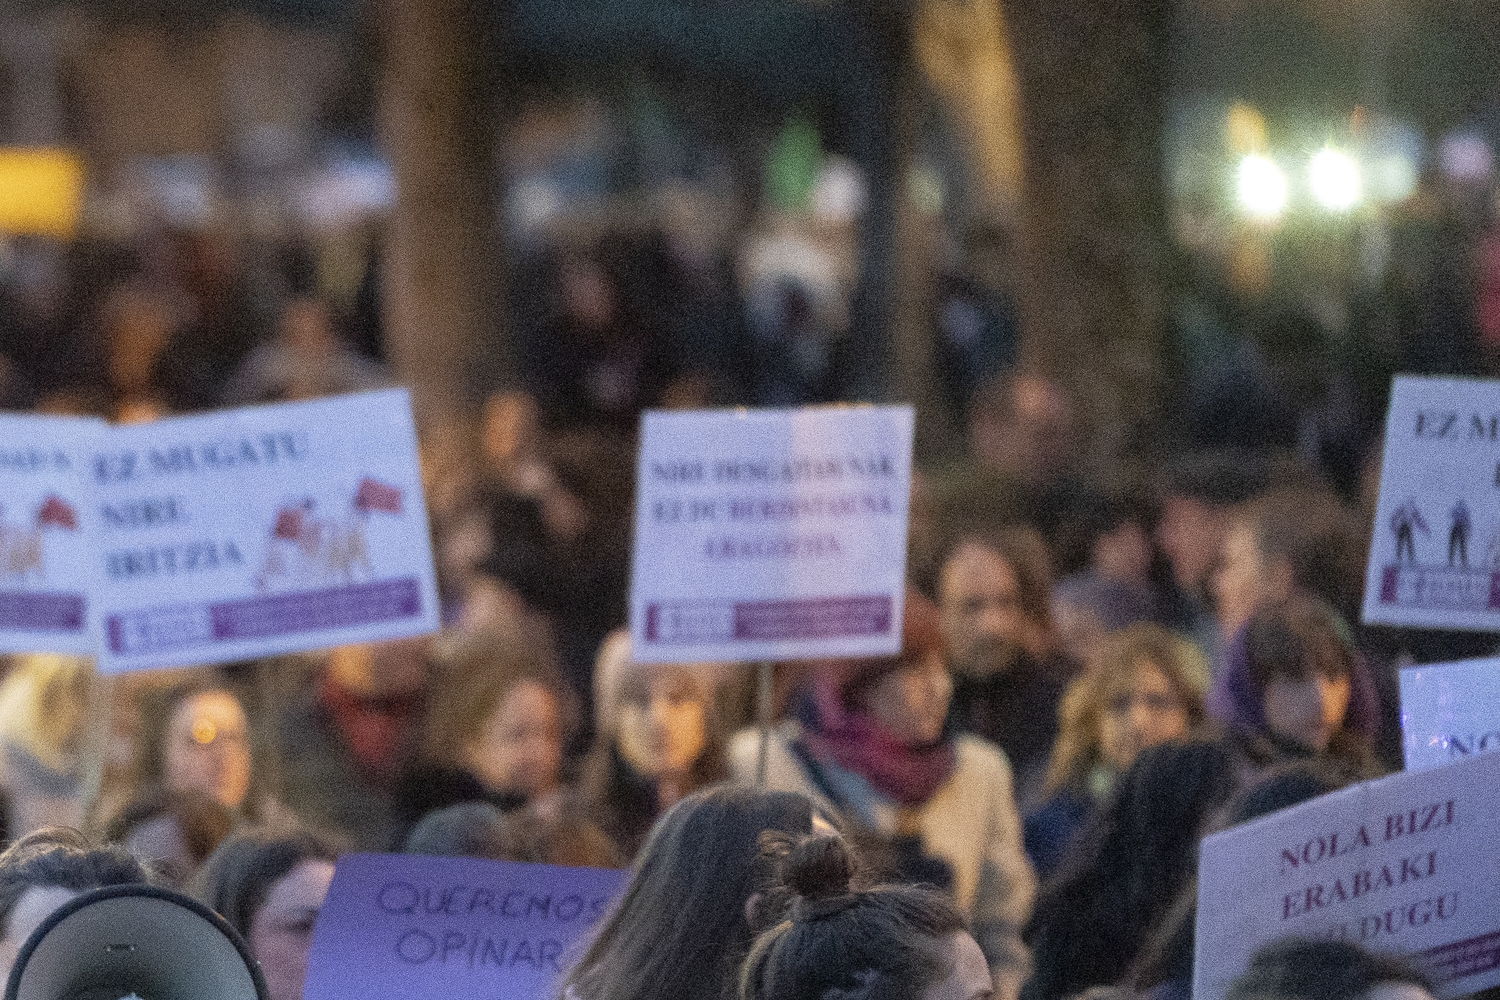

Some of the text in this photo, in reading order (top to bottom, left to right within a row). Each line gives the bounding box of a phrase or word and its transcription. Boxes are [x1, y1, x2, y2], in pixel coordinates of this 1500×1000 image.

[1415, 411, 1458, 438] EZ
[1280, 799, 1457, 876] NOLA BIZI
[1280, 850, 1438, 921] ERABAKI
[1359, 891, 1461, 943] DUGU
[396, 927, 563, 974] OPINAR
